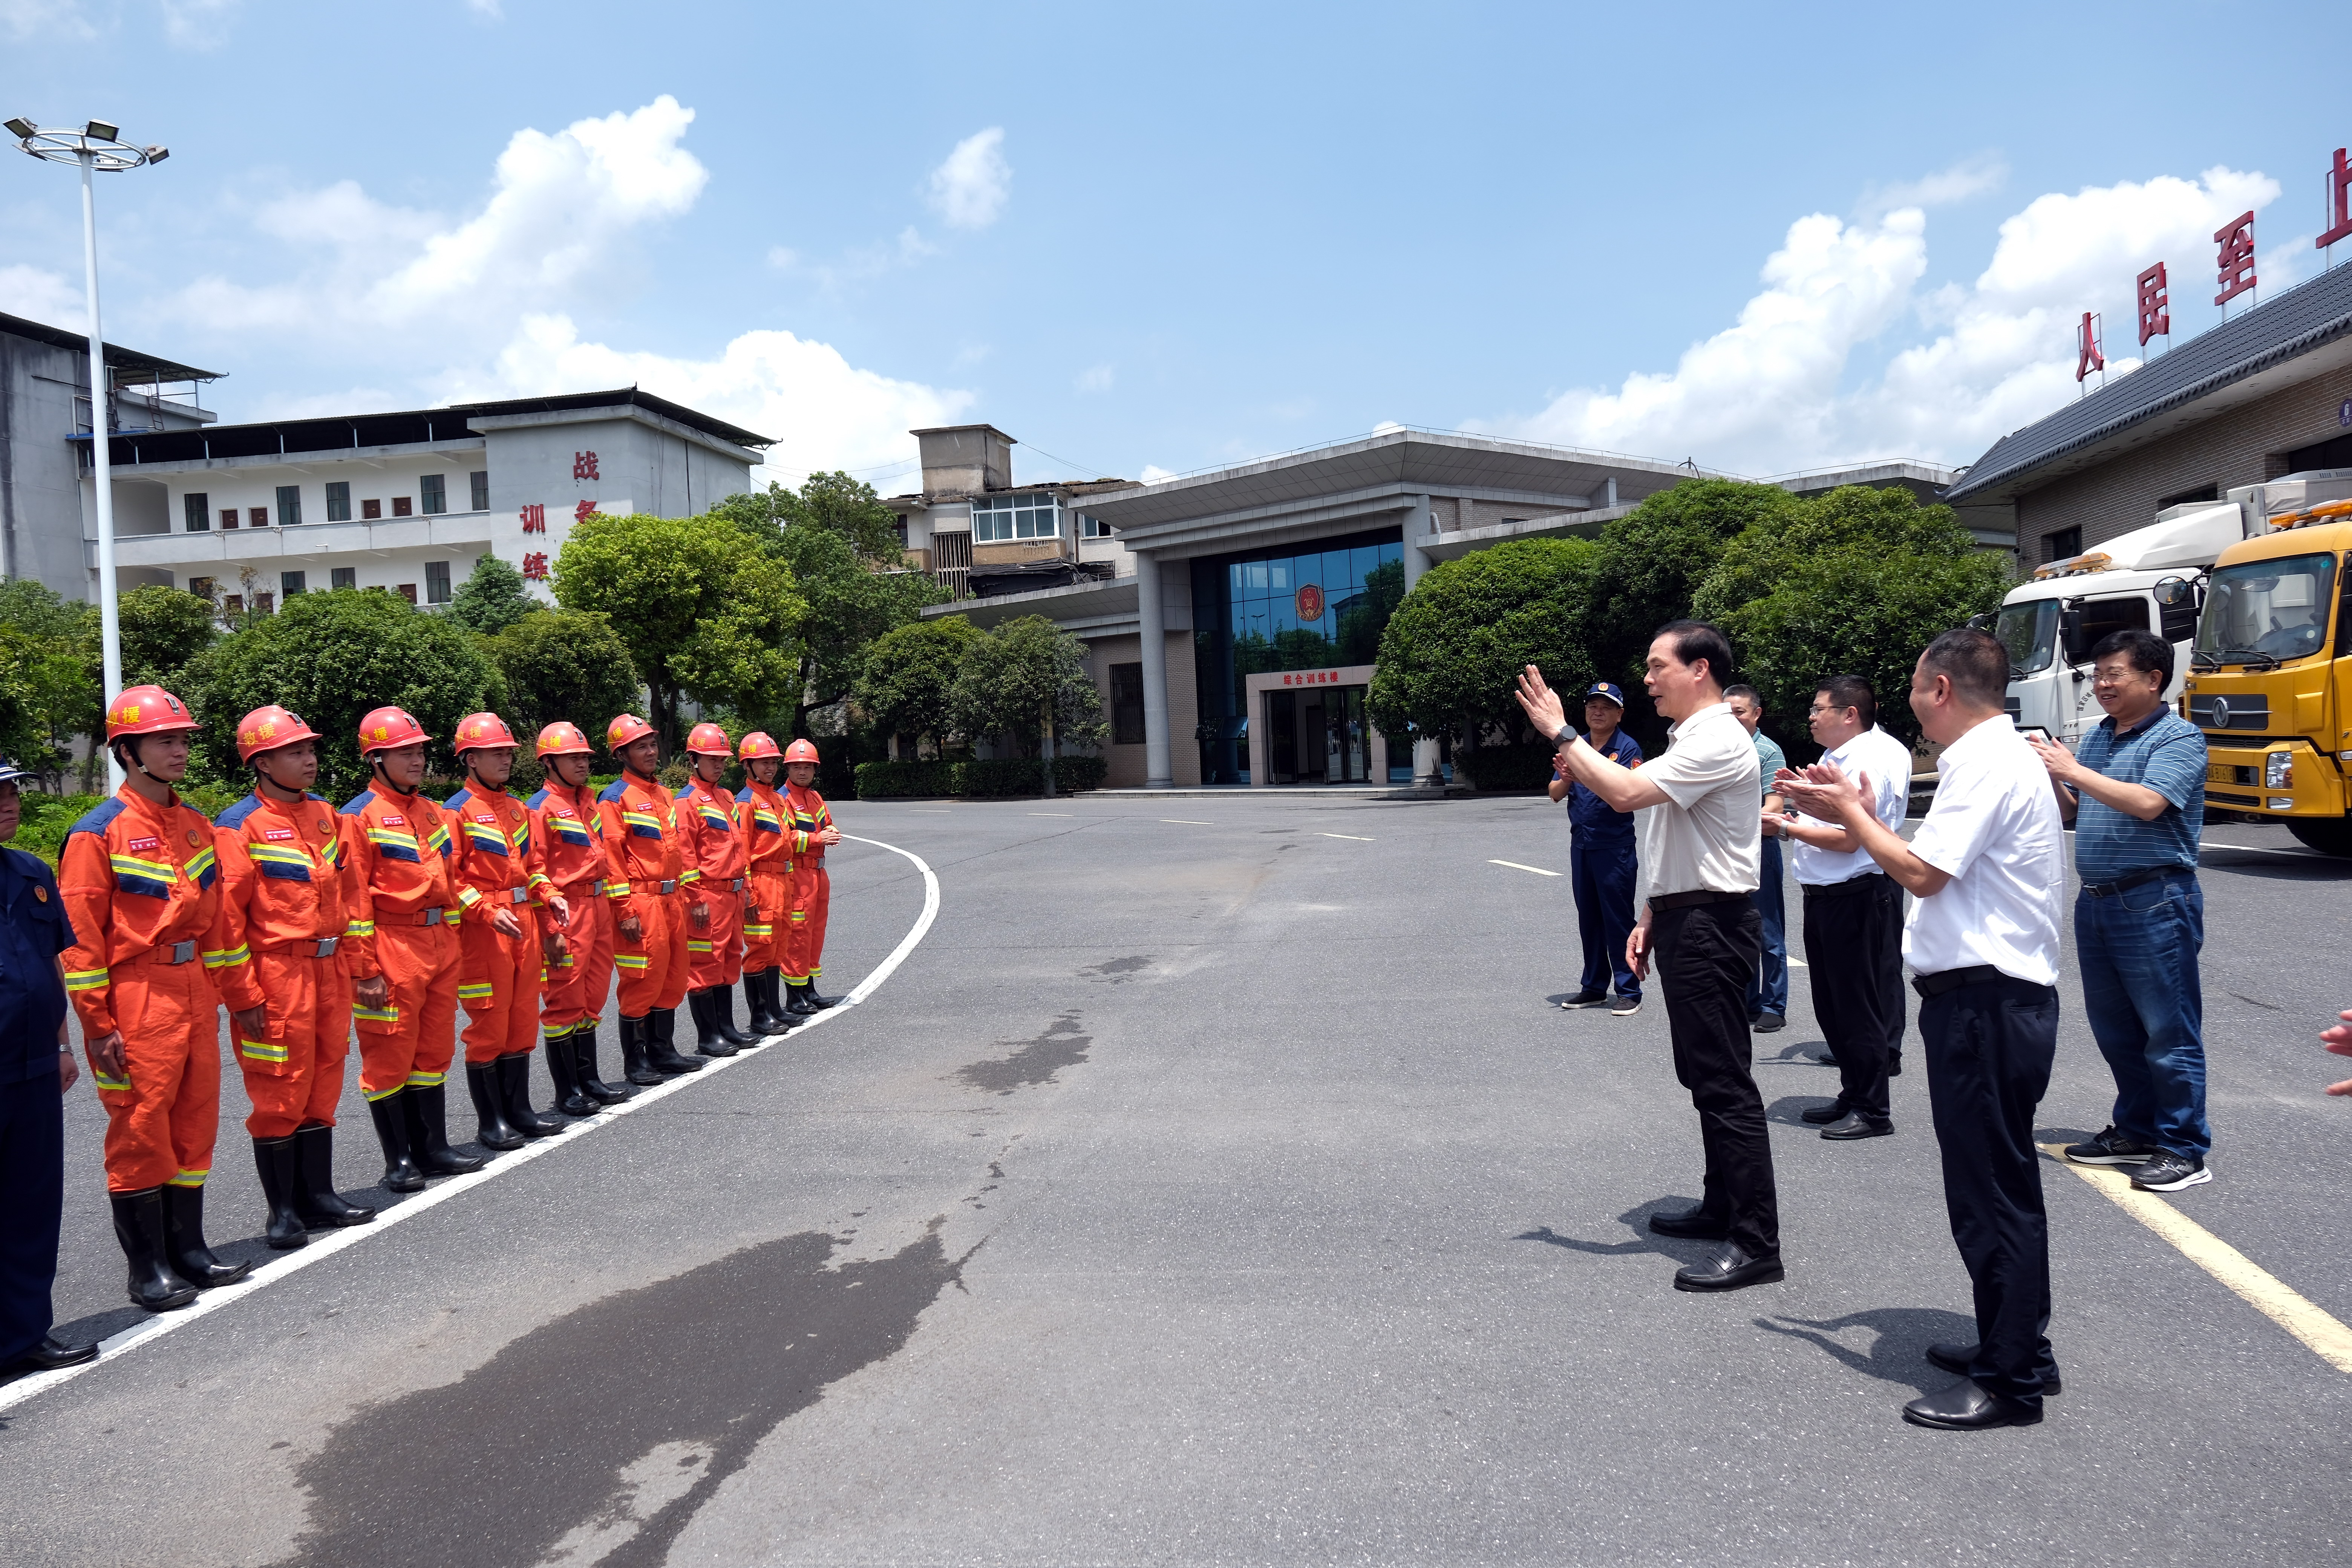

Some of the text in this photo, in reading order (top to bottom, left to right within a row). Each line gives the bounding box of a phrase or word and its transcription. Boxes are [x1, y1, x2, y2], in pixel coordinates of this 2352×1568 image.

[2344, 403, 2349, 416] 6
[519, 504, 549, 581] 训练
[1283, 671, 1338, 685] 综合训练楼
[107, 706, 140, 728] 救援
[243, 722, 276, 747] 救援
[361, 727, 389, 746] 救援
[456, 726, 482, 743] 救援
[539, 735, 561, 750] 救援
